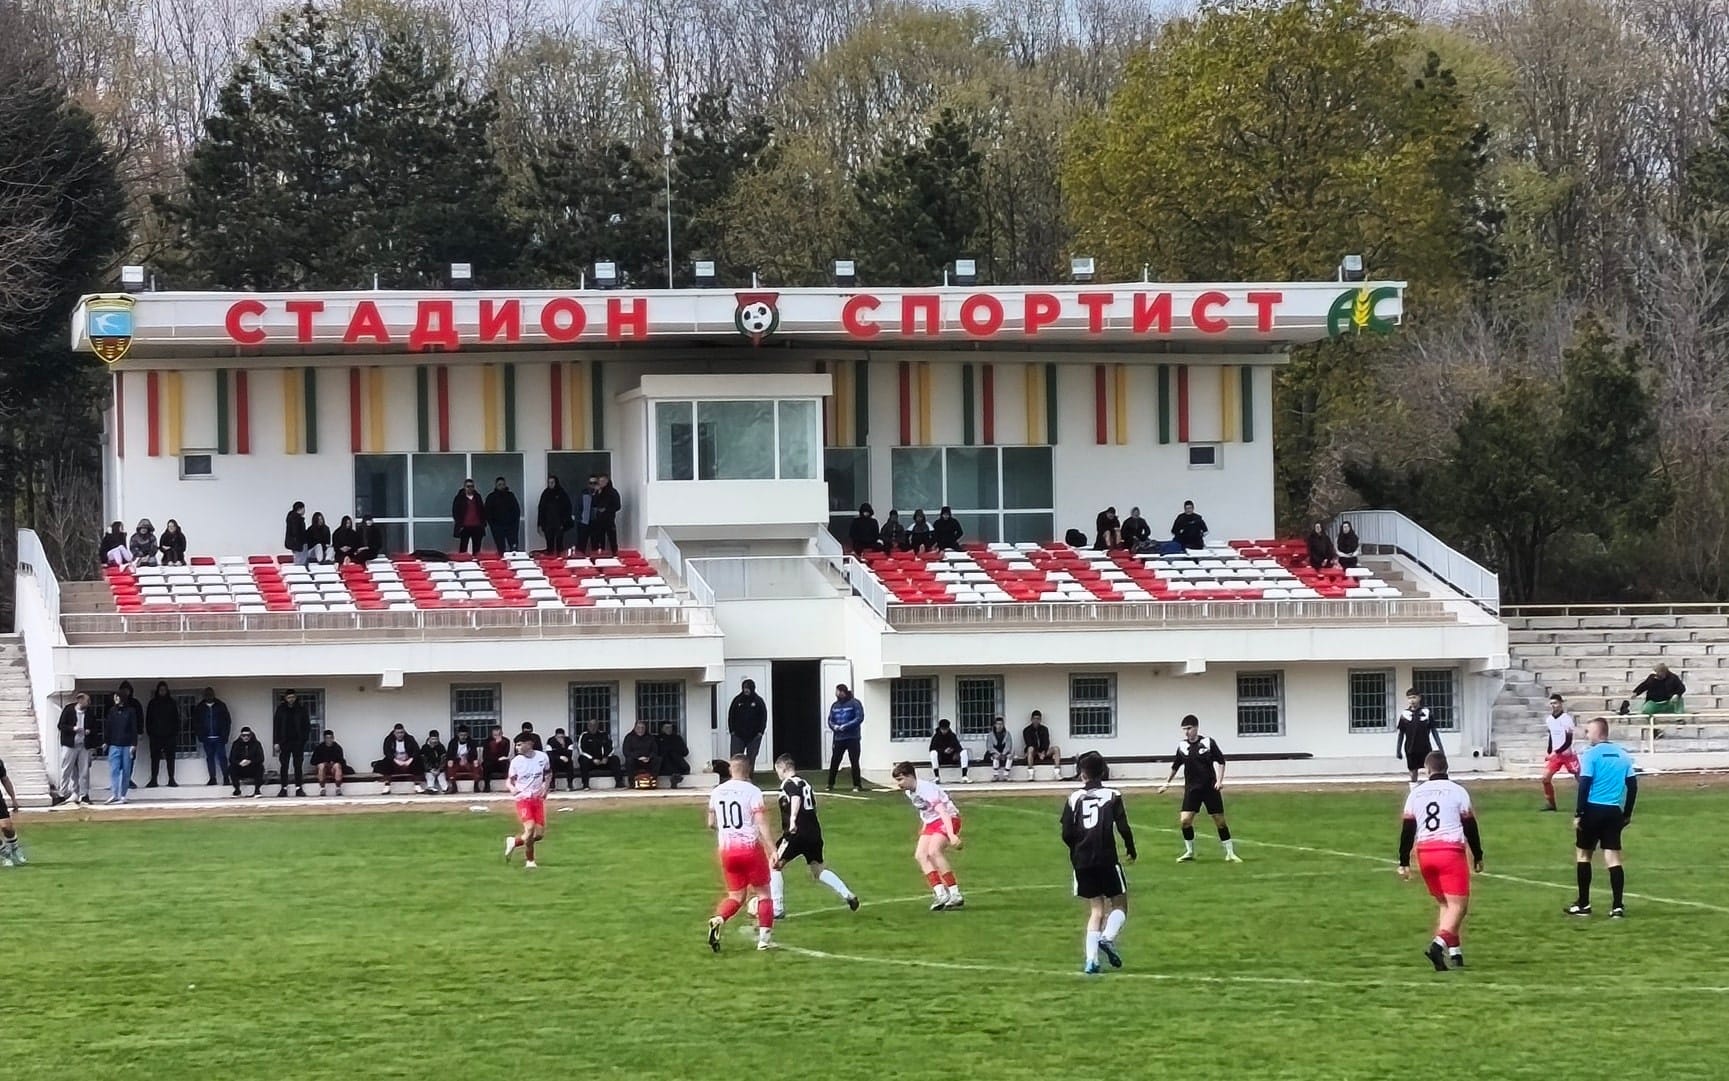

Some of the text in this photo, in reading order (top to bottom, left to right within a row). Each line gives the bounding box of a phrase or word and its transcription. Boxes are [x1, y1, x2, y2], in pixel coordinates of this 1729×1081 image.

[225, 299, 648, 351] СТАДИОН
[842, 292, 1283, 339] СПОРТИСТ
[719, 800, 744, 830] 10
[1081, 799, 1099, 830] 5
[1425, 801, 1441, 832] 8
